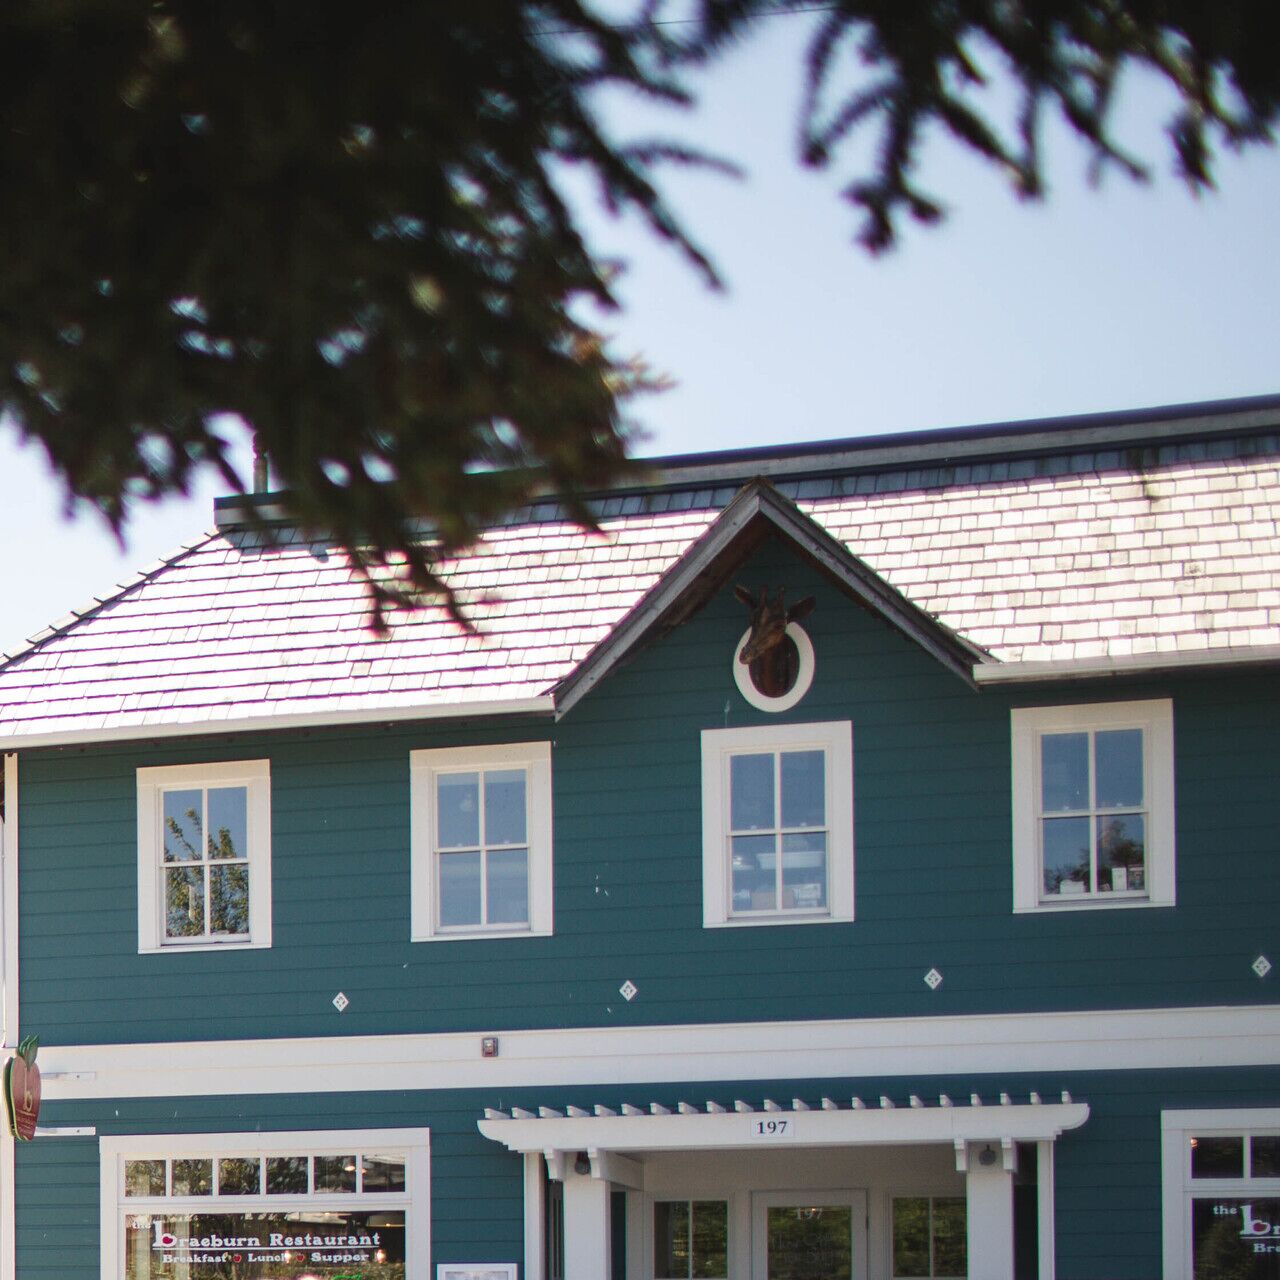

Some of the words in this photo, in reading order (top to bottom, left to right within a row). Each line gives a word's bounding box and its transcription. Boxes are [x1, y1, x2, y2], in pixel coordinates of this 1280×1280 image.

[756, 1121, 788, 1134] 197
[1213, 1205, 1237, 1215] the
[152, 1220, 261, 1247] braeburn
[269, 1232, 380, 1247] Restaurant
[162, 1252, 227, 1263] Breakfast
[311, 1252, 370, 1263] Supper
